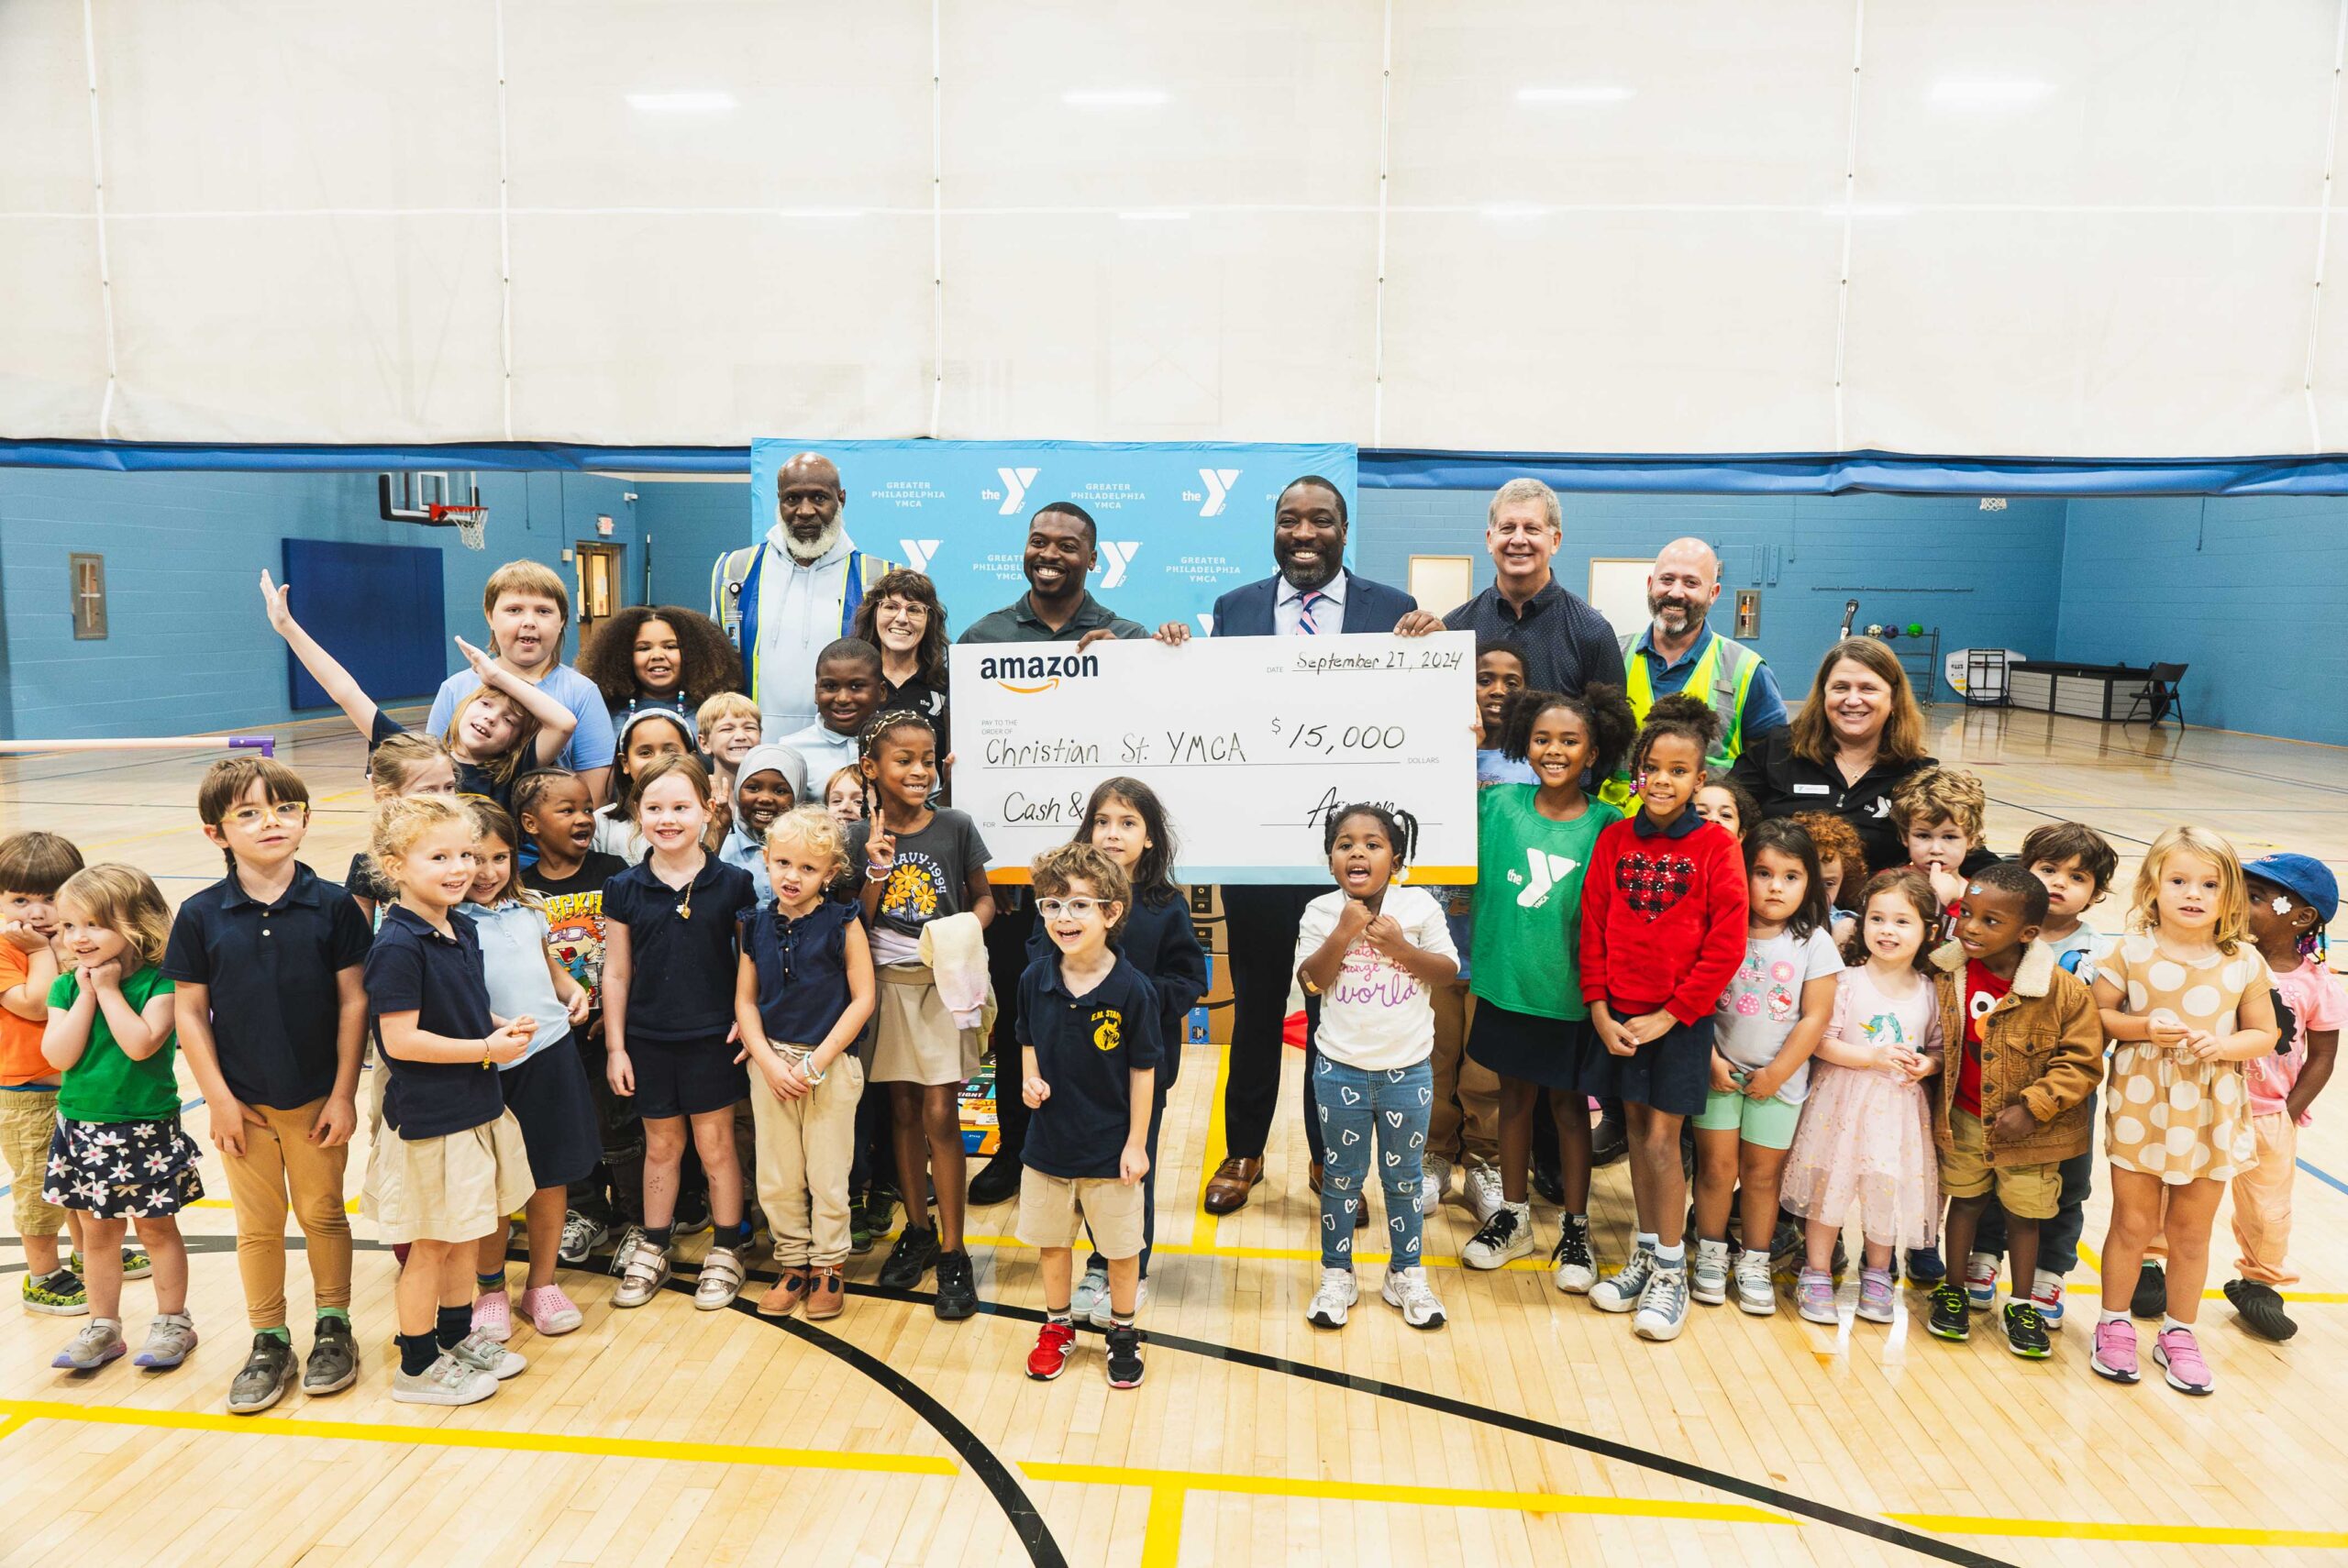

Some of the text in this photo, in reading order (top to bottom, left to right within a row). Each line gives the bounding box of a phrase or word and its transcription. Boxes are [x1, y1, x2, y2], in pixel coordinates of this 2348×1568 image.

[886, 481, 931, 490] GREATER
[871, 491, 946, 499] PHILADELPHIA
[980, 489, 1000, 501] the
[1070, 491, 1146, 500] PHILADELPHIA
[1182, 491, 1202, 502] the
[1095, 502, 1122, 510] YMCA
[1180, 557, 1226, 565] GREATER
[973, 563, 1024, 571] PHILADEL
[1166, 565, 1241, 574] PHILADELPHIA
[996, 572, 1023, 580] YMCA
[1189, 575, 1217, 583] YMCA
[980, 654, 1099, 680] amazon
[1296, 651, 1379, 675] September
[1421, 651, 1463, 670] 2024
[1289, 723, 1406, 756] 15,000
[986, 731, 1246, 767] Christian St. YMCA
[1003, 791, 1085, 823] Cash &
[1507, 868, 1523, 886] the
[1335, 973, 1420, 1007] world
